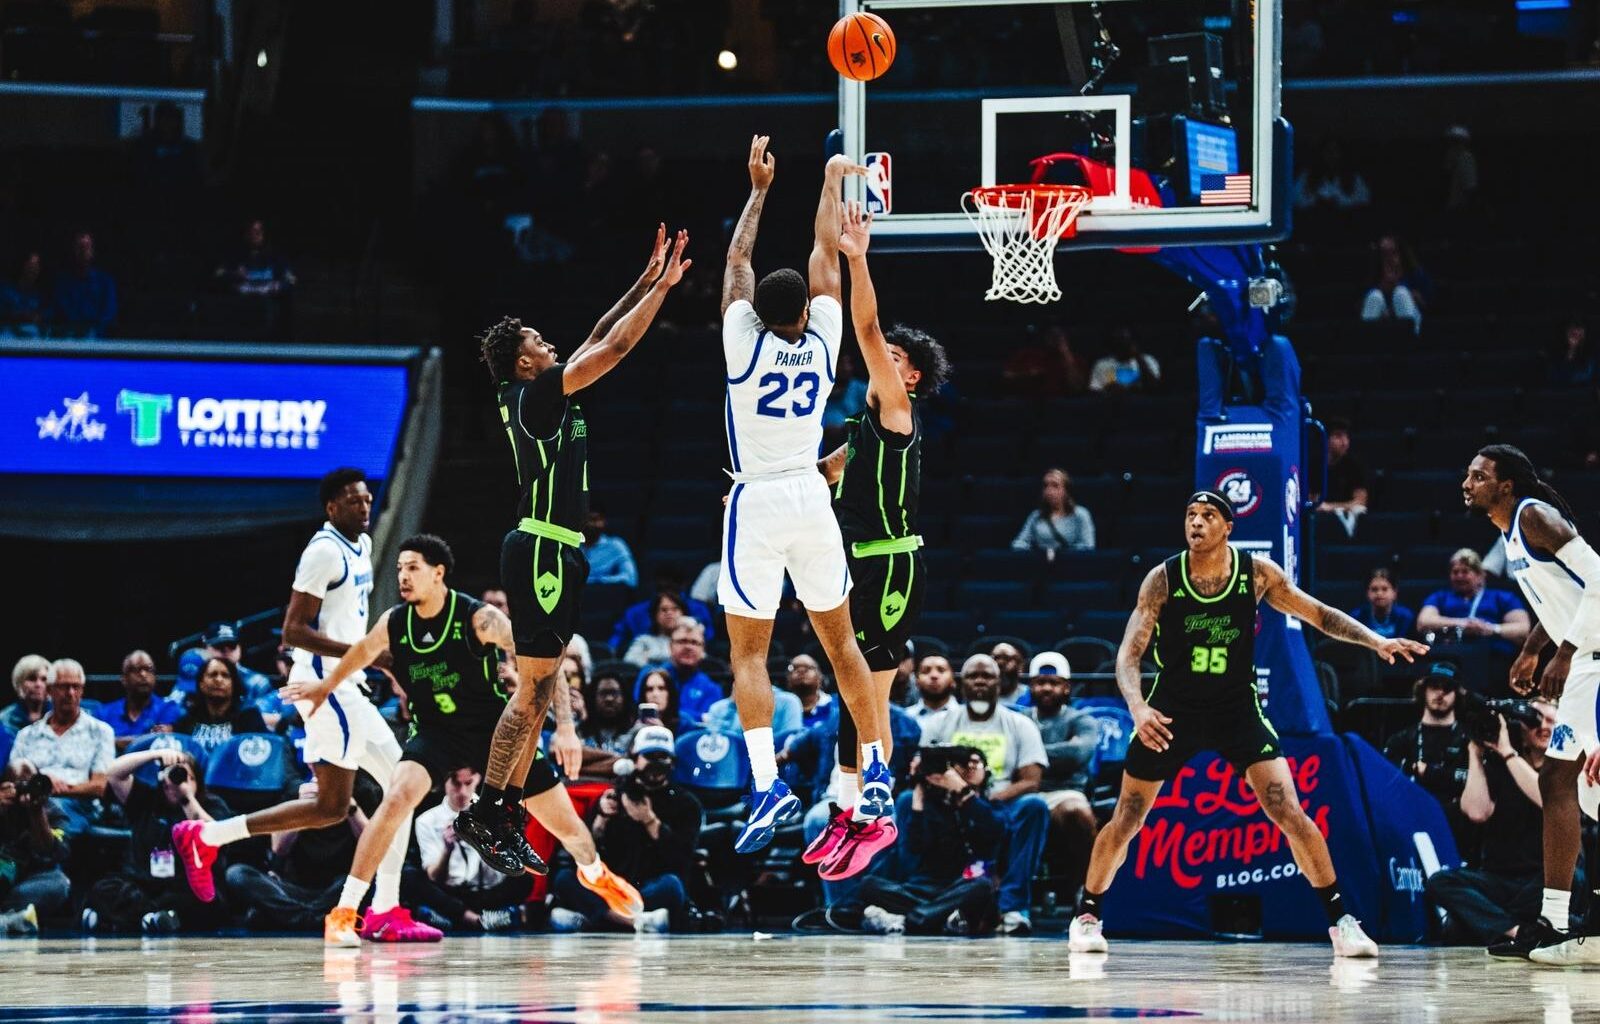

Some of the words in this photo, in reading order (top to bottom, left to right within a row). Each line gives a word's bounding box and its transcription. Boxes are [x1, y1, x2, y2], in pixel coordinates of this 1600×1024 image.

[775, 351, 813, 366] PARKER
[757, 372, 820, 418] 23
[178, 397, 326, 433] LOTTERY
[180, 432, 319, 450] TENNESSEE
[1226, 479, 1251, 503] 24
[1191, 646, 1228, 674] 35
[433, 693, 457, 713] 3
[1135, 800, 1330, 889] Memphs
